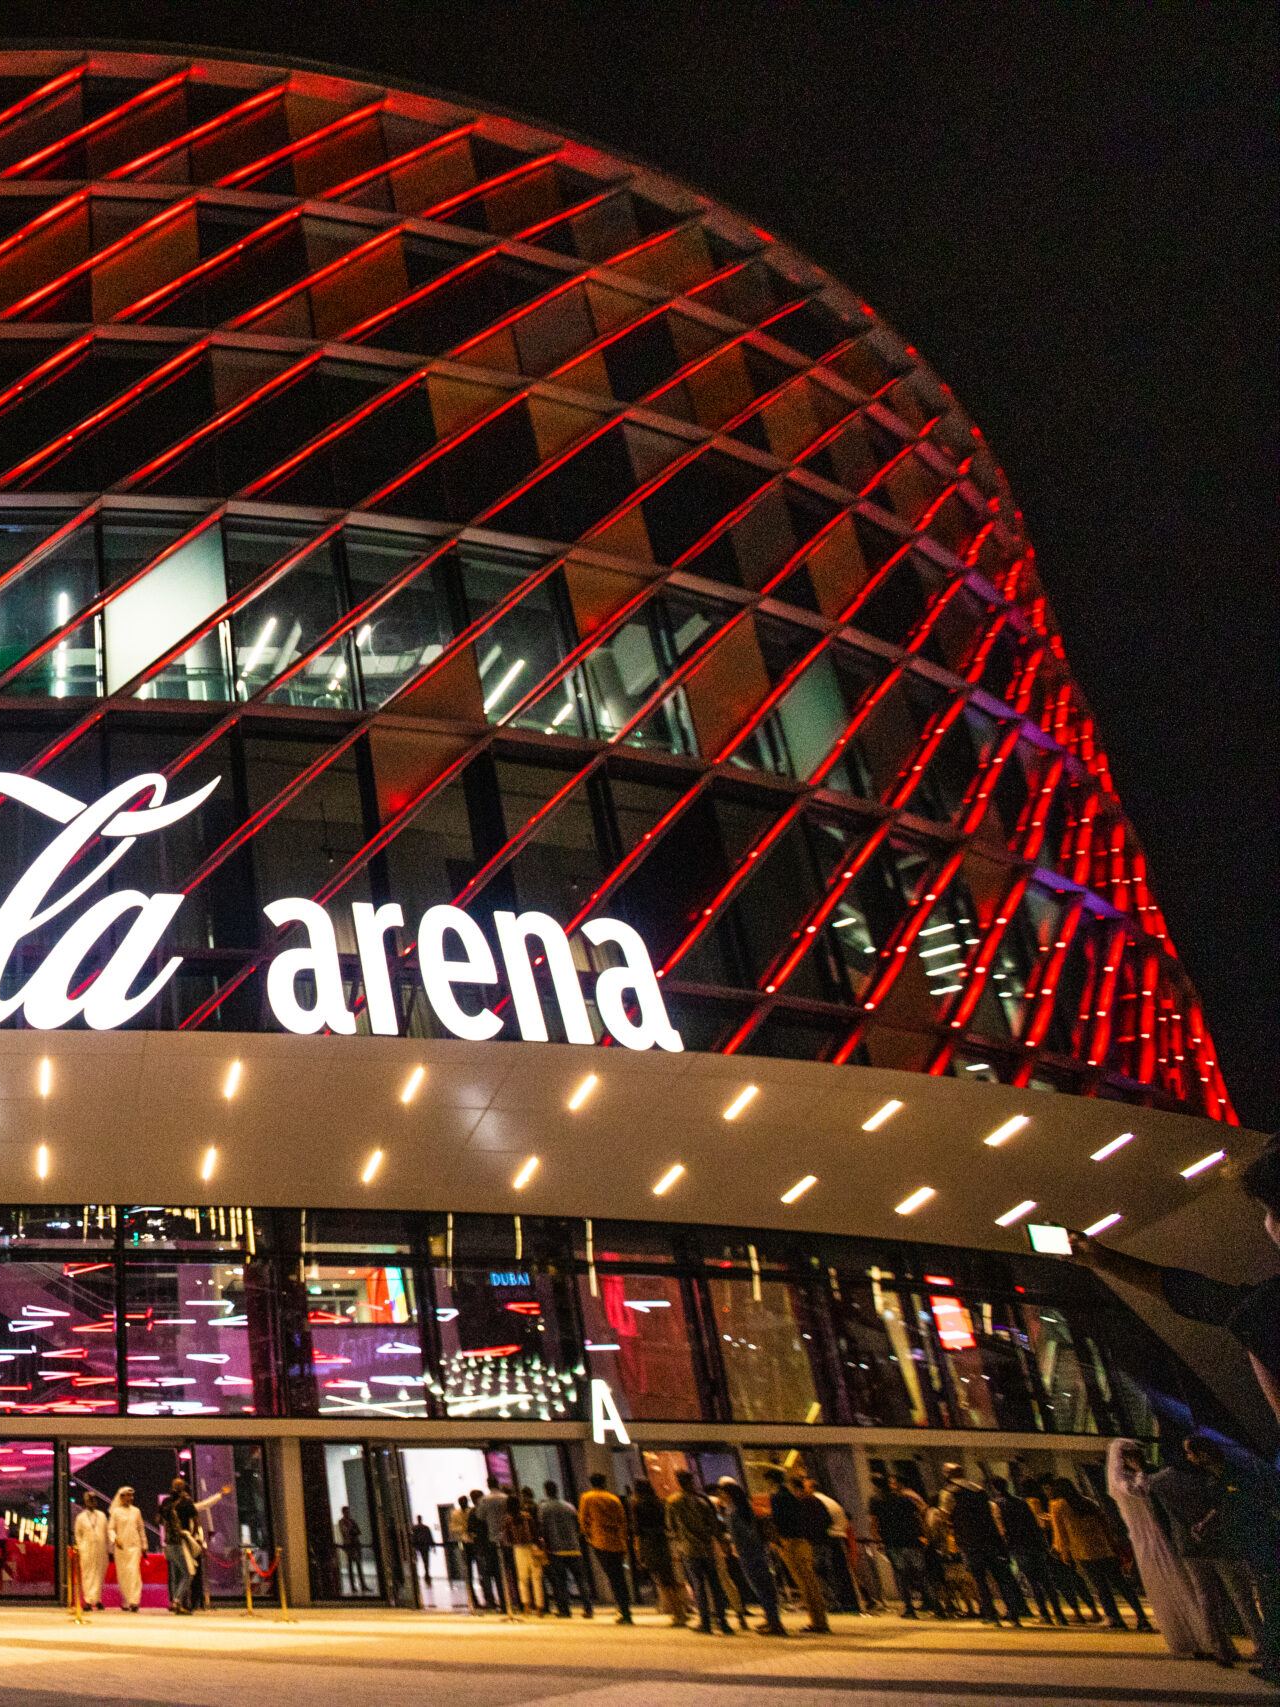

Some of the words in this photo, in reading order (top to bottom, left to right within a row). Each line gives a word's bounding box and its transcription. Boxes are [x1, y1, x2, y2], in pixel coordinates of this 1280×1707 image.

[263, 897, 685, 1053] arena
[490, 1272, 530, 1286] DUBAI
[592, 1378, 631, 1445] A
